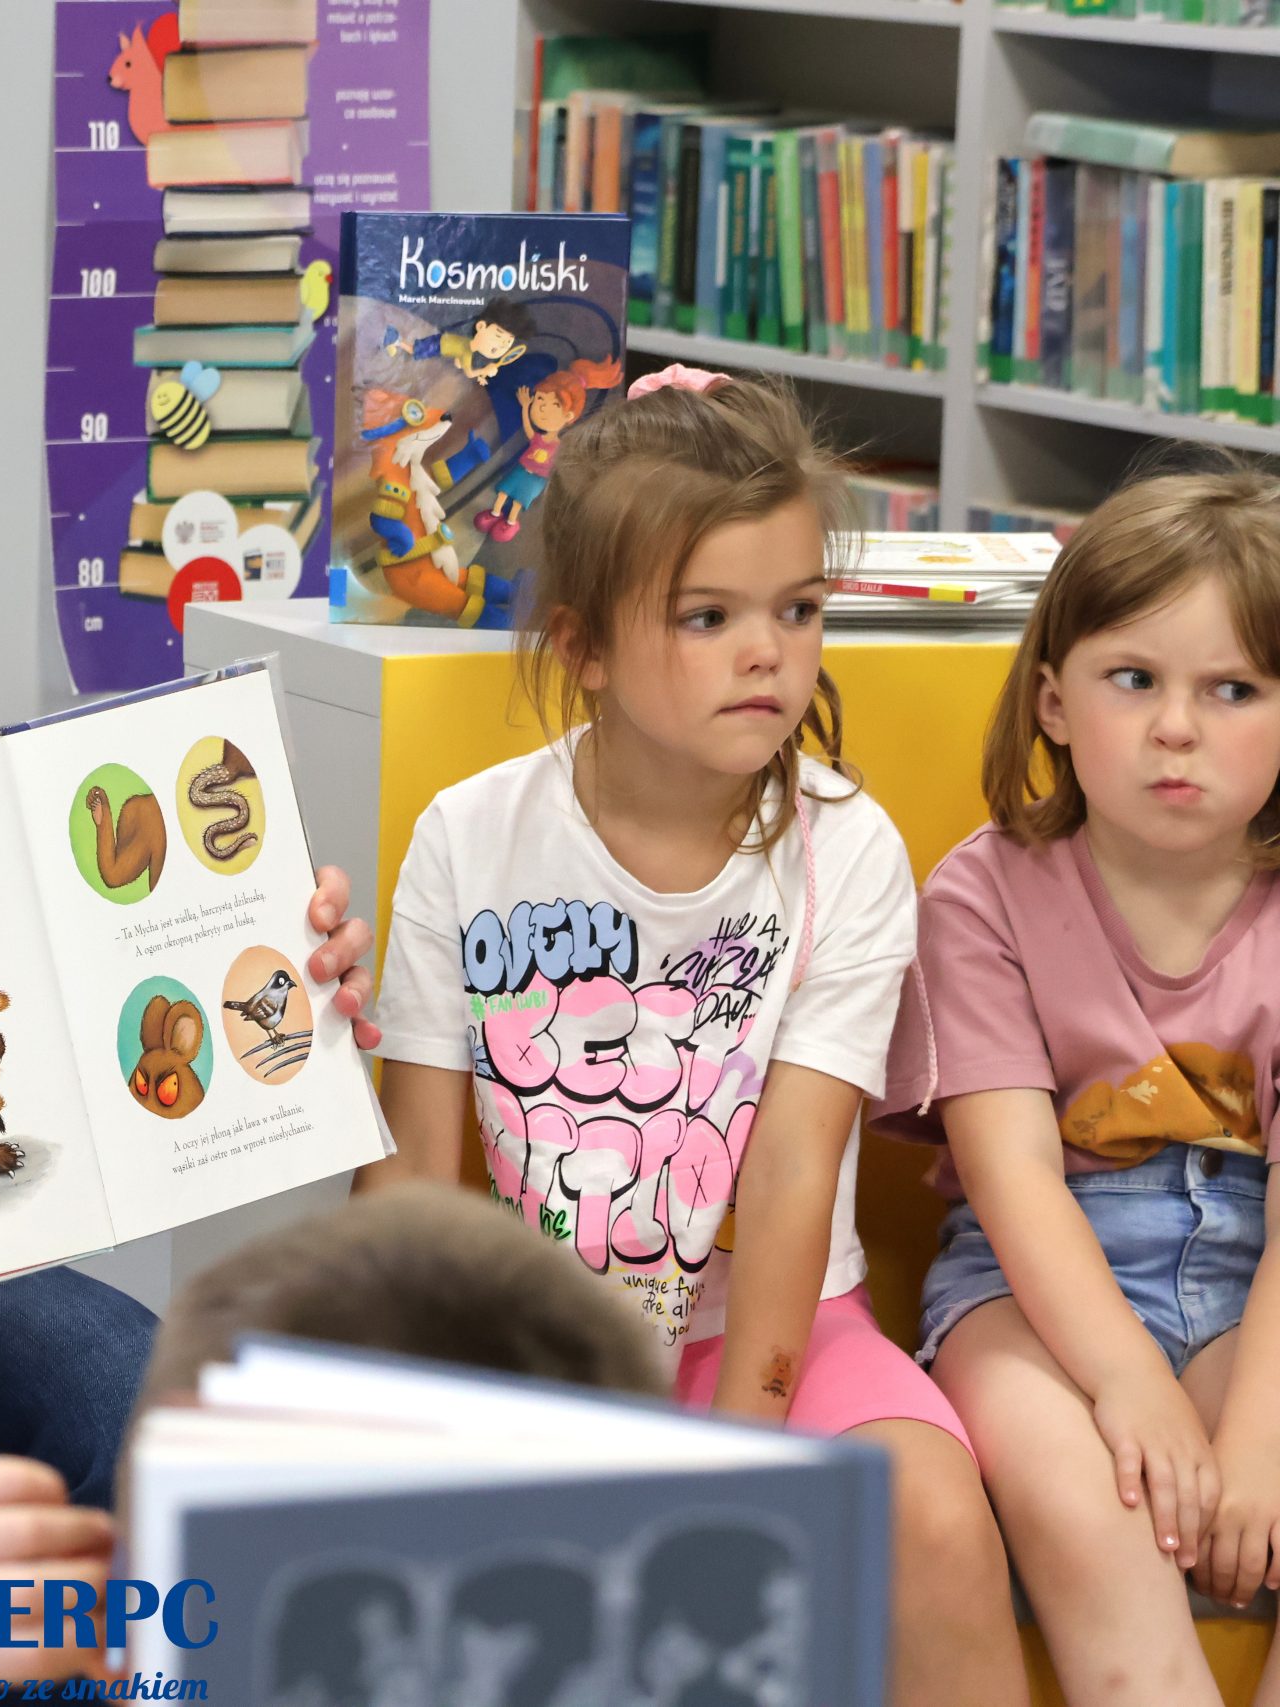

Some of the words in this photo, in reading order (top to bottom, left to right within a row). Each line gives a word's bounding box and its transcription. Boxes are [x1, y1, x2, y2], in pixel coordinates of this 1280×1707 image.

[88, 121, 120, 150] 110
[399, 234, 589, 292] Kosmoliski
[80, 268, 117, 297] 100
[399, 294, 426, 304] Marek
[428, 295, 484, 306] Marcinowski
[81, 413, 109, 442] 90
[78, 557, 104, 587] 80
[84, 616, 103, 632] cm
[121, 927, 133, 940] Ta
[134, 919, 159, 938] Mycha
[160, 917, 174, 933] jest
[175, 908, 200, 924] wielką,
[199, 902, 233, 919] barczystą
[233, 888, 267, 909] dzikuską.
[757, 913, 781, 942] A
[135, 945, 143, 958] A
[144, 943, 162, 957] ogon
[164, 934, 194, 949] okropną
[194, 924, 222, 943] pokryty
[223, 920, 234, 932] ma
[235, 911, 257, 928] łuską.
[460, 897, 639, 998] OVELY
[488, 993, 513, 1015] FAN
[173, 1141, 182, 1153] A
[183, 1136, 199, 1150] oczy
[200, 1134, 210, 1146] jej
[211, 1126, 231, 1145] płoną
[232, 1120, 244, 1137] jak
[245, 1116, 261, 1131] lawa
[262, 1116, 268, 1125] w
[270, 1103, 305, 1122] wulkanie,
[172, 1156, 196, 1175] wąsiki
[197, 1153, 209, 1167] zaś
[210, 1149, 228, 1162] ostre
[230, 1145, 242, 1155] ma
[243, 1136, 267, 1154] wprost
[268, 1120, 315, 1142] niesłychanie.
[622, 1273, 669, 1294] unique
